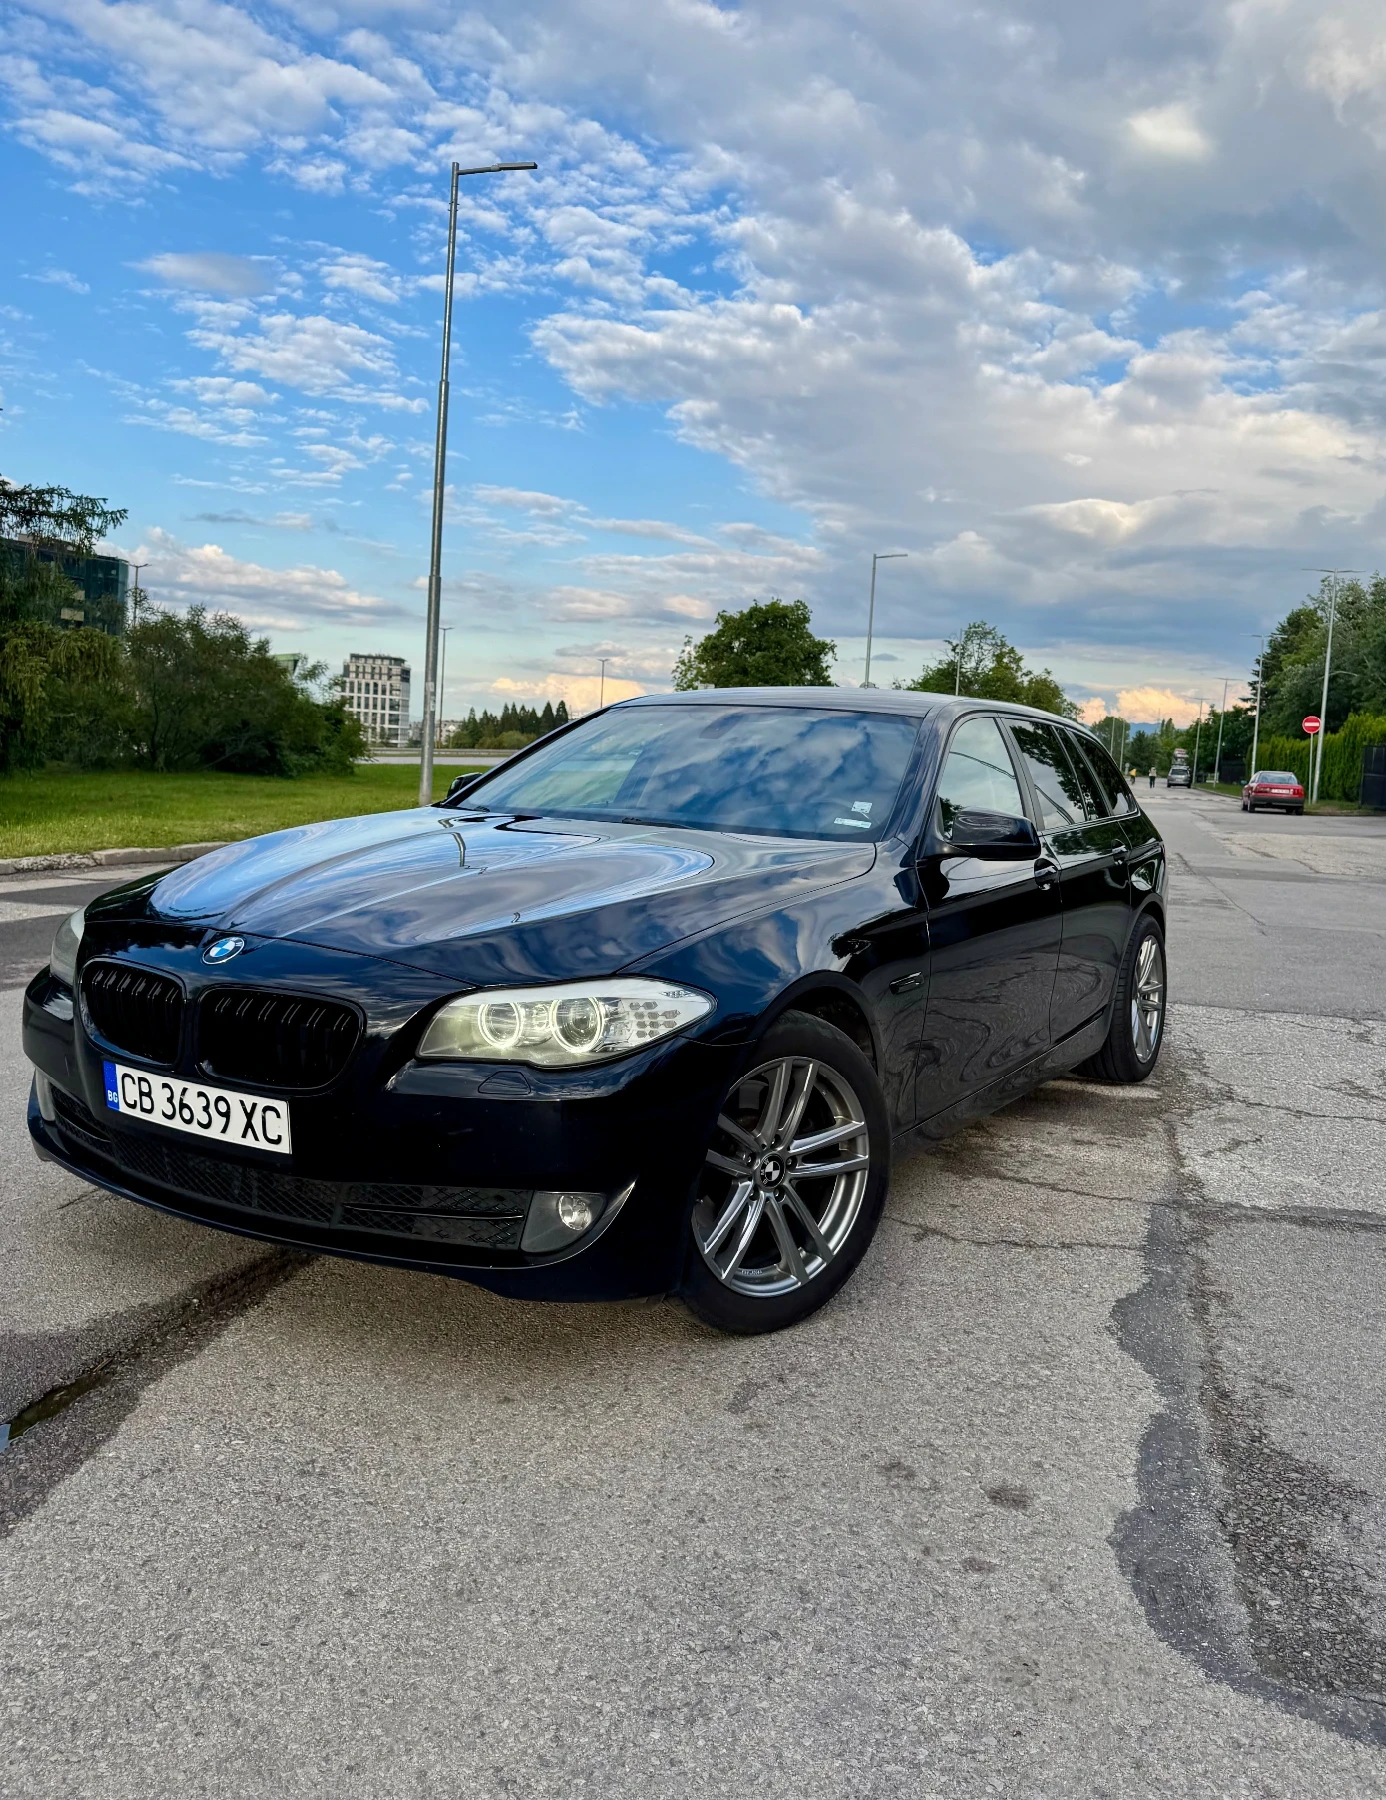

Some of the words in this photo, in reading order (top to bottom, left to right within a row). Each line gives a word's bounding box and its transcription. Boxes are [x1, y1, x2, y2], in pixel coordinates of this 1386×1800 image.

[107, 1090, 118, 1103] BG
[121, 1072, 155, 1115] CB
[161, 1082, 231, 1134] 3639
[239, 1099, 282, 1145] XC
